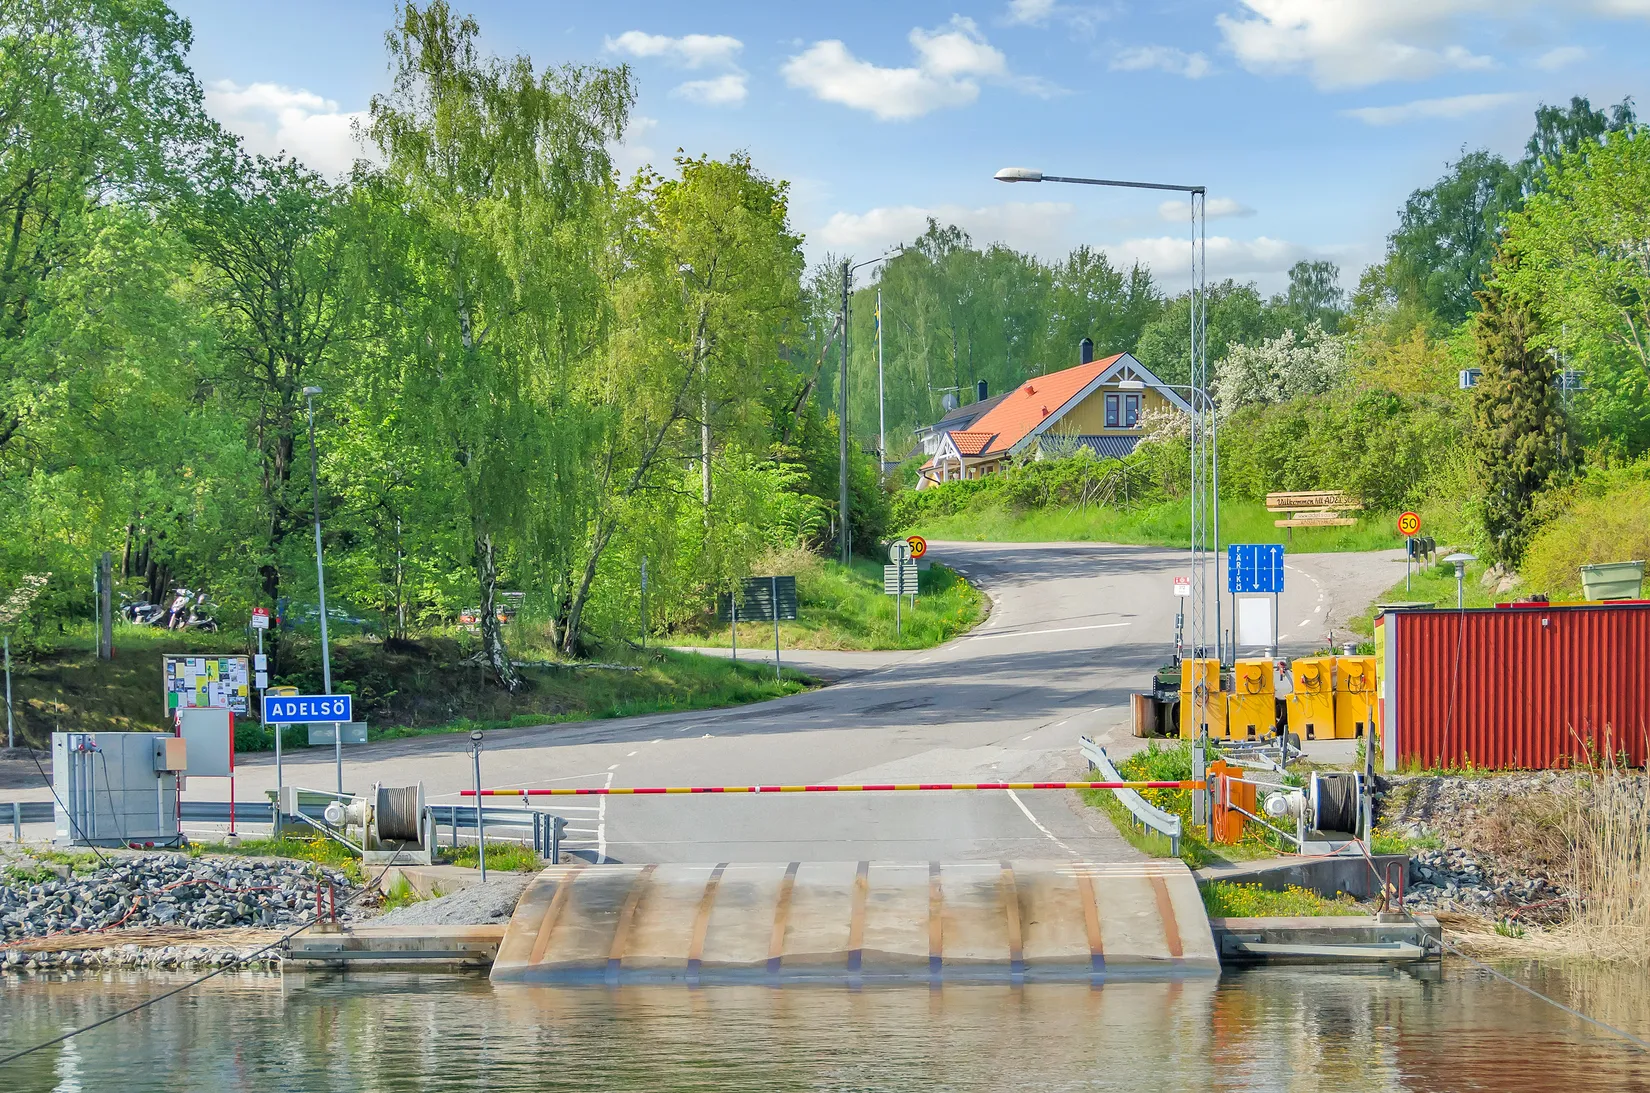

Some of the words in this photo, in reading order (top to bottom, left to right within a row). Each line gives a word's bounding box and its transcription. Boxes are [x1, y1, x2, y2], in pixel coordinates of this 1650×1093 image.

[1402, 518, 1417, 529] 50
[908, 541, 923, 553] 50
[272, 699, 345, 716] ADELSÖ
